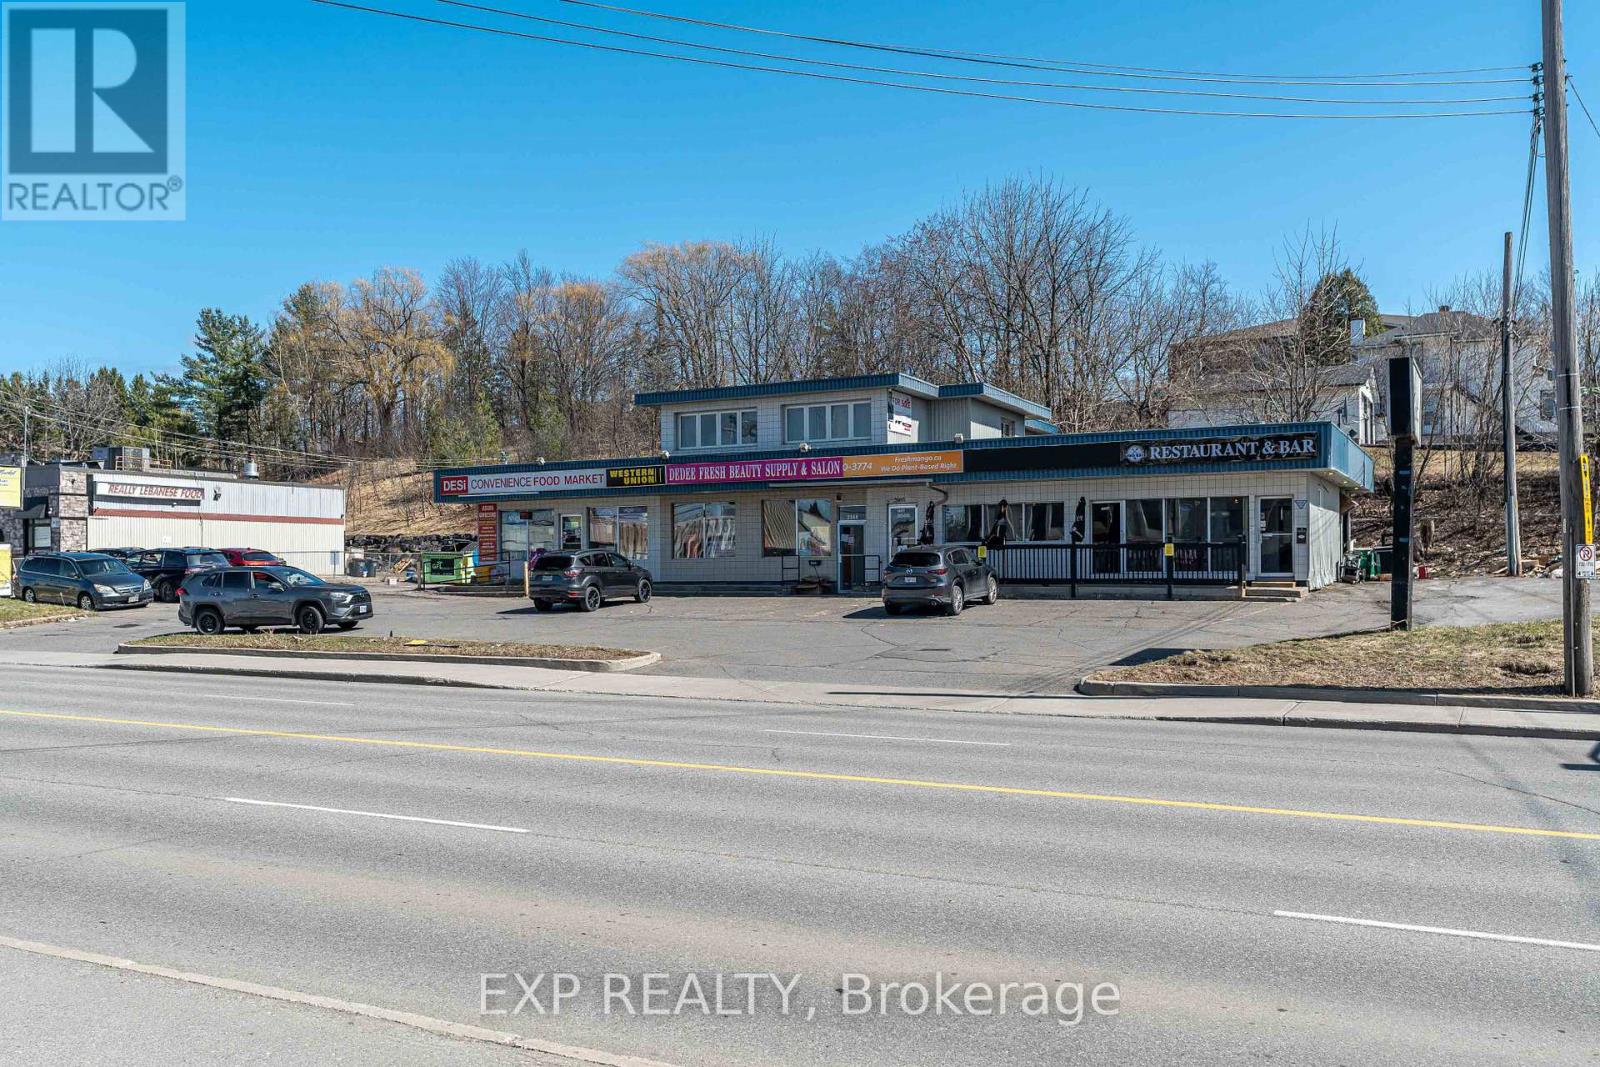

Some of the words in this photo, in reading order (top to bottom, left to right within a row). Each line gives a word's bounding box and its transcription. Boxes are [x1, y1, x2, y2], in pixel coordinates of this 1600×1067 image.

[1150, 442, 1259, 460] RESTAURANT
[1262, 441, 1276, 455] &
[1278, 439, 1316, 454] BAR
[609, 467, 654, 478] WESTERN
[669, 466, 696, 481] DEDEE
[699, 465, 726, 480] FRESH
[729, 464, 762, 479] BEAUTY
[765, 462, 799, 477] SUPPLY
[801, 463, 808, 476] &
[811, 460, 841, 475] SALON
[470, 476, 532, 490] CONVENIENCE
[533, 475, 560, 487] FOOD
[564, 473, 605, 485] MARKET
[623, 475, 655, 485] UNION
[108, 484, 137, 495] REALLY
[139, 485, 178, 498] LEBANESE
